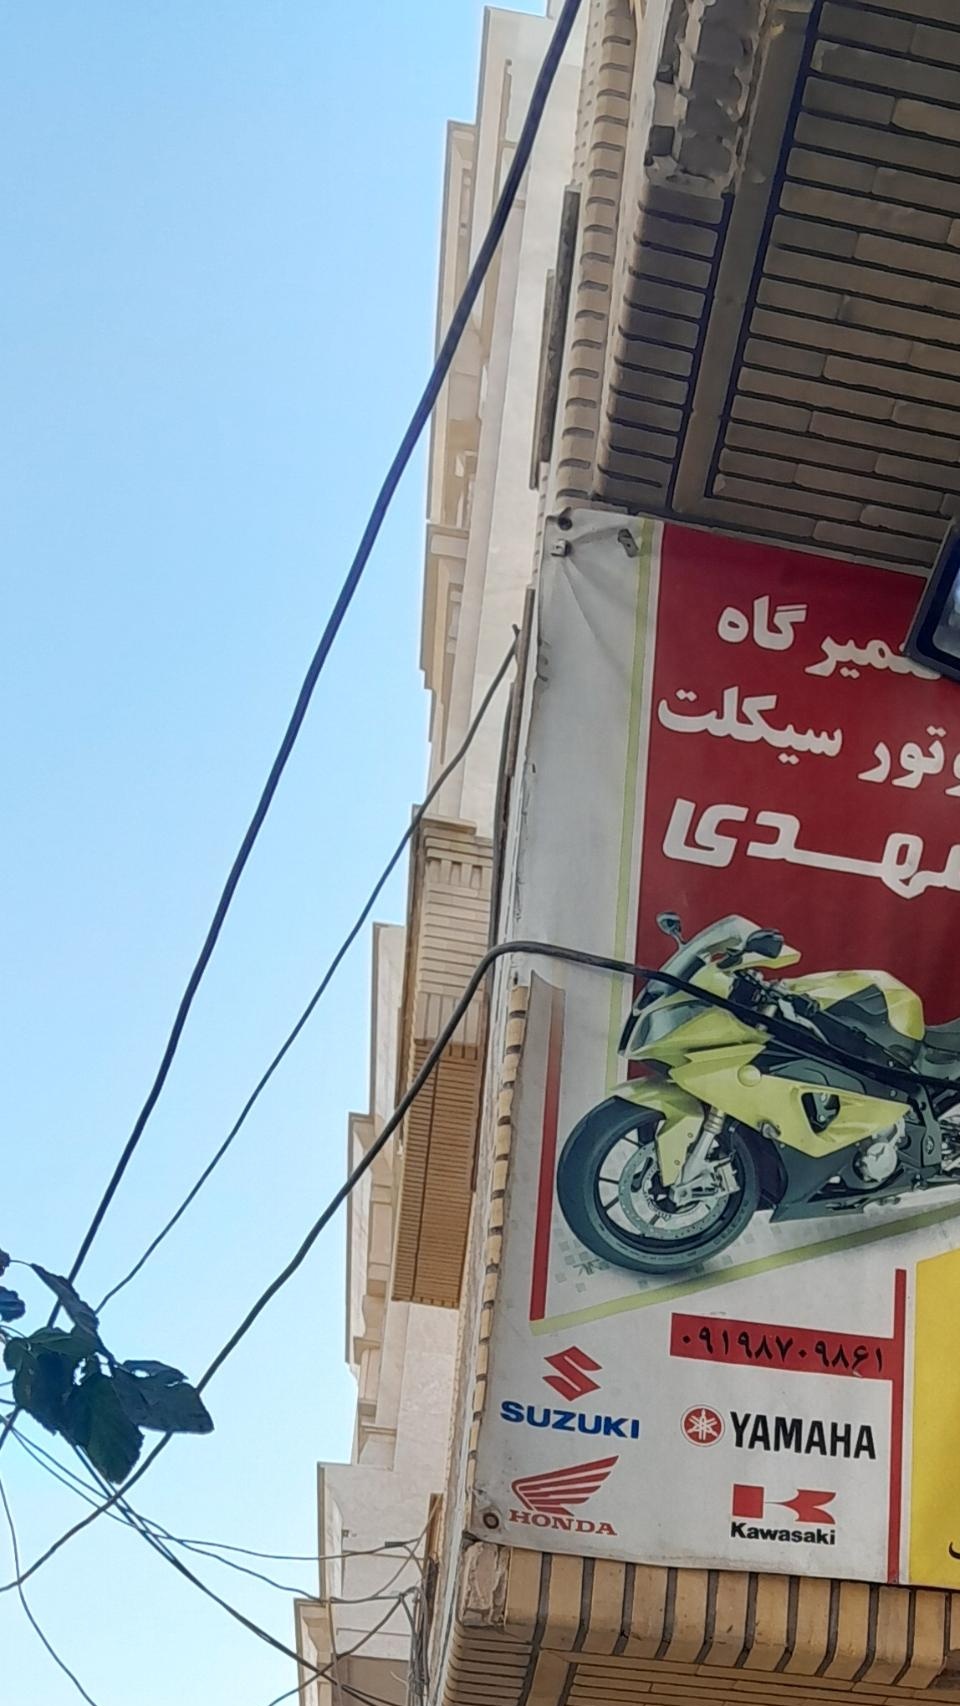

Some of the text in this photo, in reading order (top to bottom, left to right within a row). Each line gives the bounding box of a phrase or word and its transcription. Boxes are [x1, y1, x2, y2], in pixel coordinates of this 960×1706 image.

[717, 595, 943, 680] میر گاه
[656, 685, 843, 765] سیکلت
[500, 1400, 640, 1439] SUZUKI
[729, 1411, 876, 1460] YAMAHA
[507, 1508, 618, 1537] HONDA
[730, 1521, 836, 1545] Kawasaki
